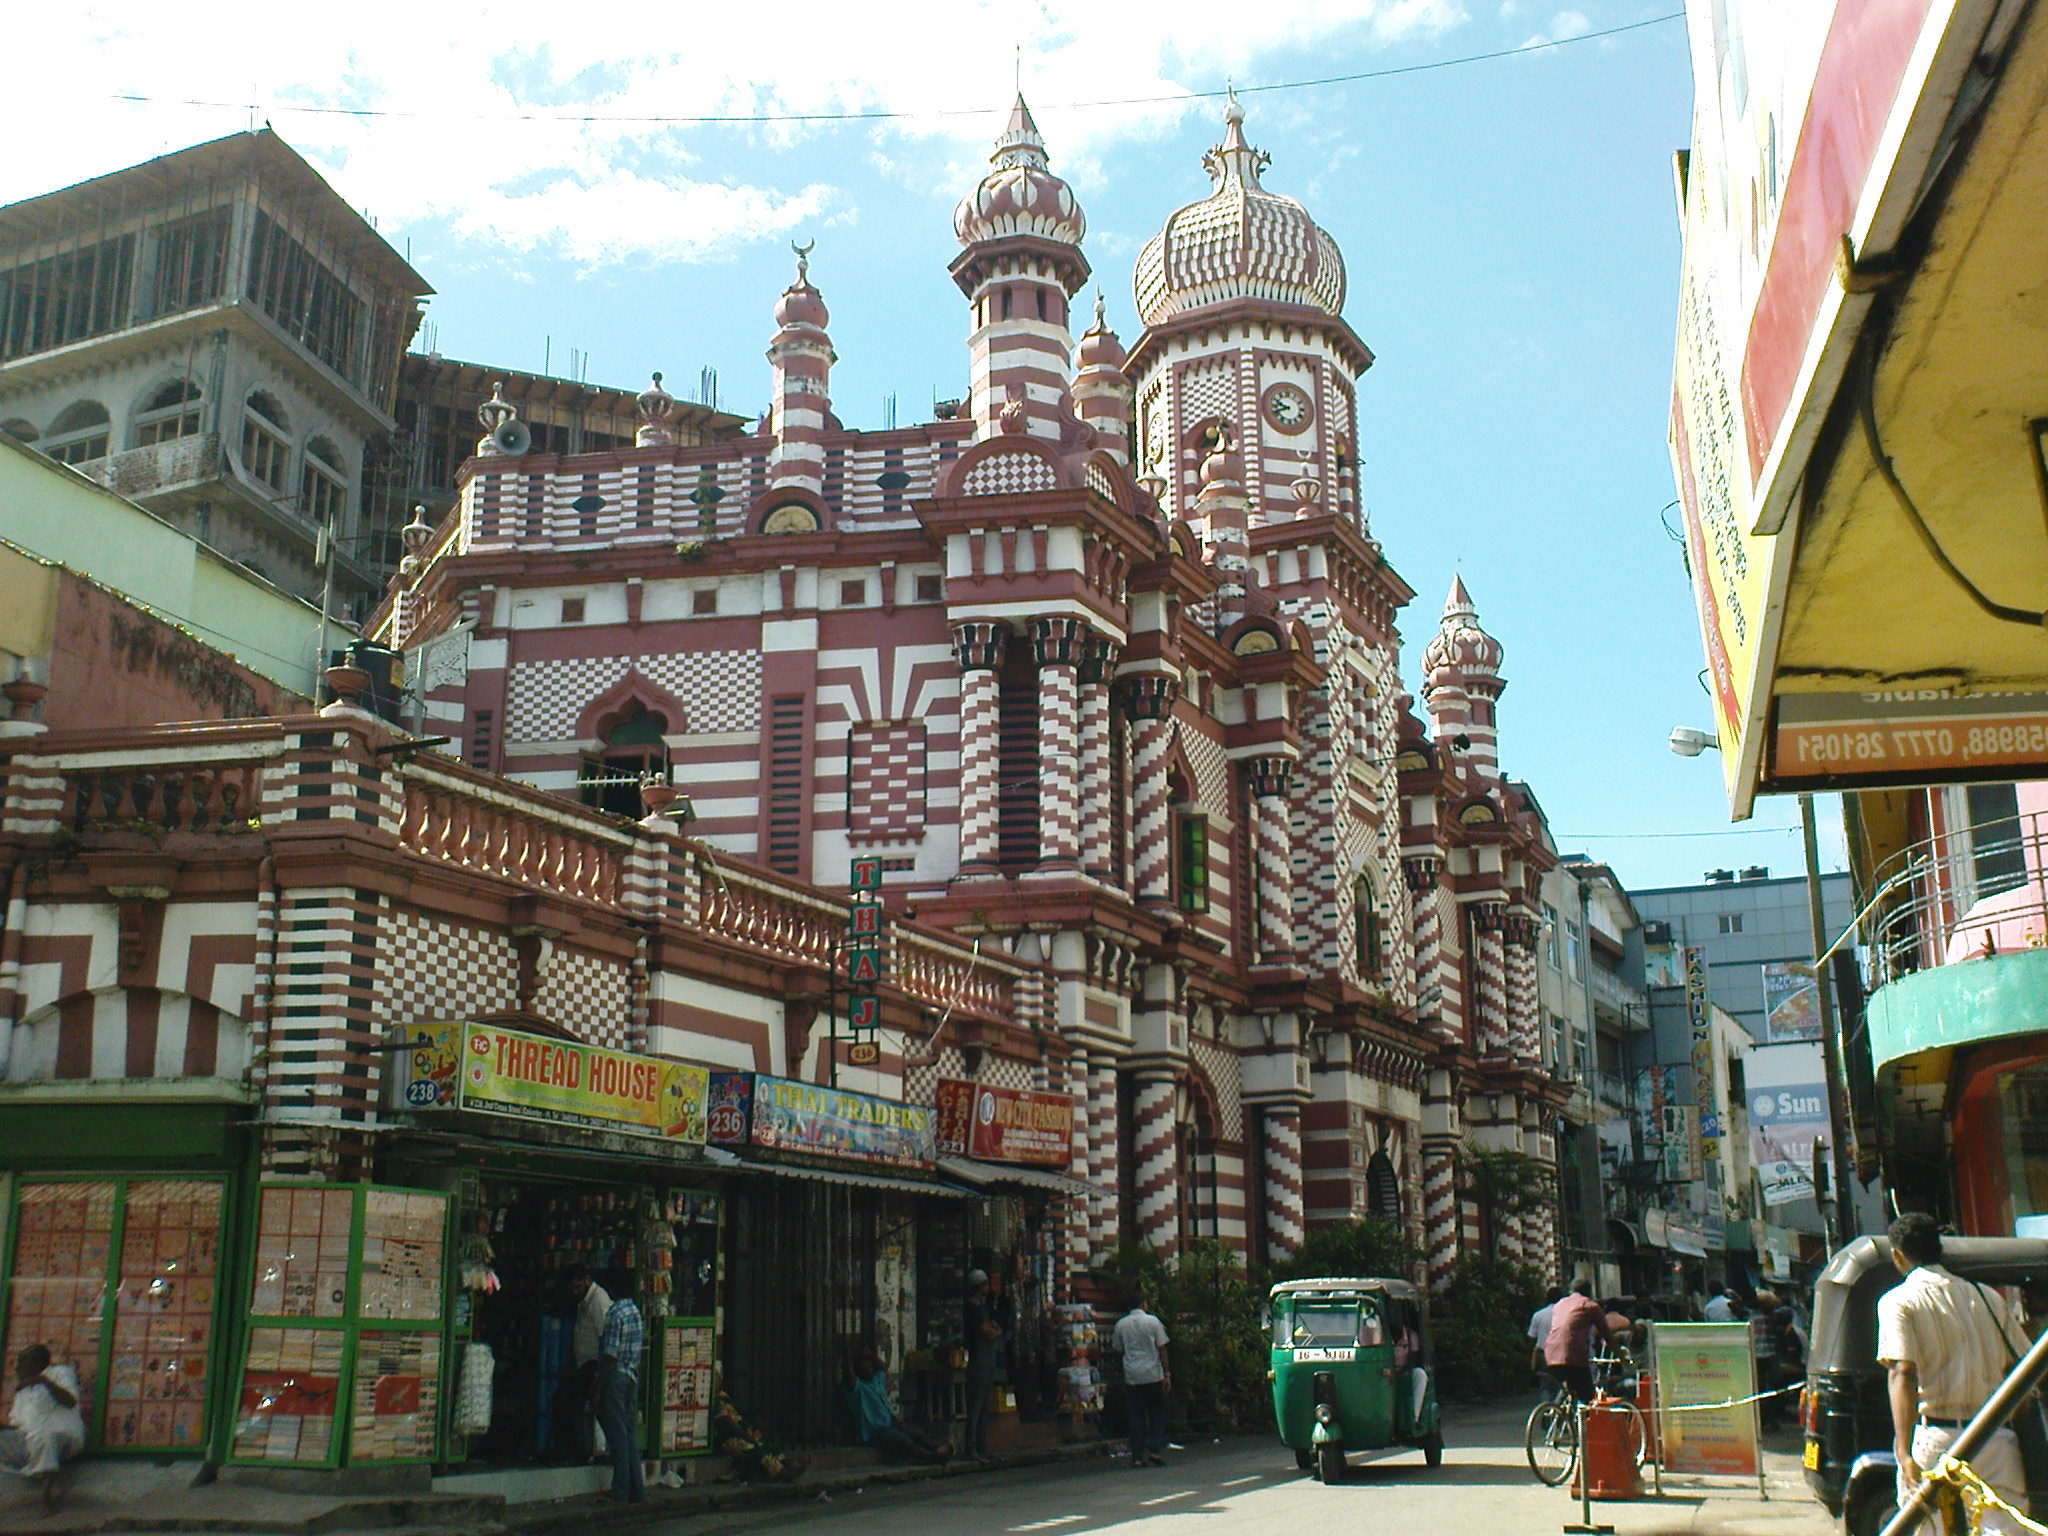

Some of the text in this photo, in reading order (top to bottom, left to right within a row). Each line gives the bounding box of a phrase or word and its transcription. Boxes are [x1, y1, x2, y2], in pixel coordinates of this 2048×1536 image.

[1688, 952, 1708, 1041] FASHION
[495, 1034, 581, 1089] THREAD
[588, 1053, 658, 1103] HOUSE
[410, 1084, 435, 1101] 238
[772, 1084, 827, 1115] THAJ
[835, 1096, 928, 1131] TRADERS
[1778, 1093, 1821, 1115] Sun
[711, 1111, 742, 1132] 236
